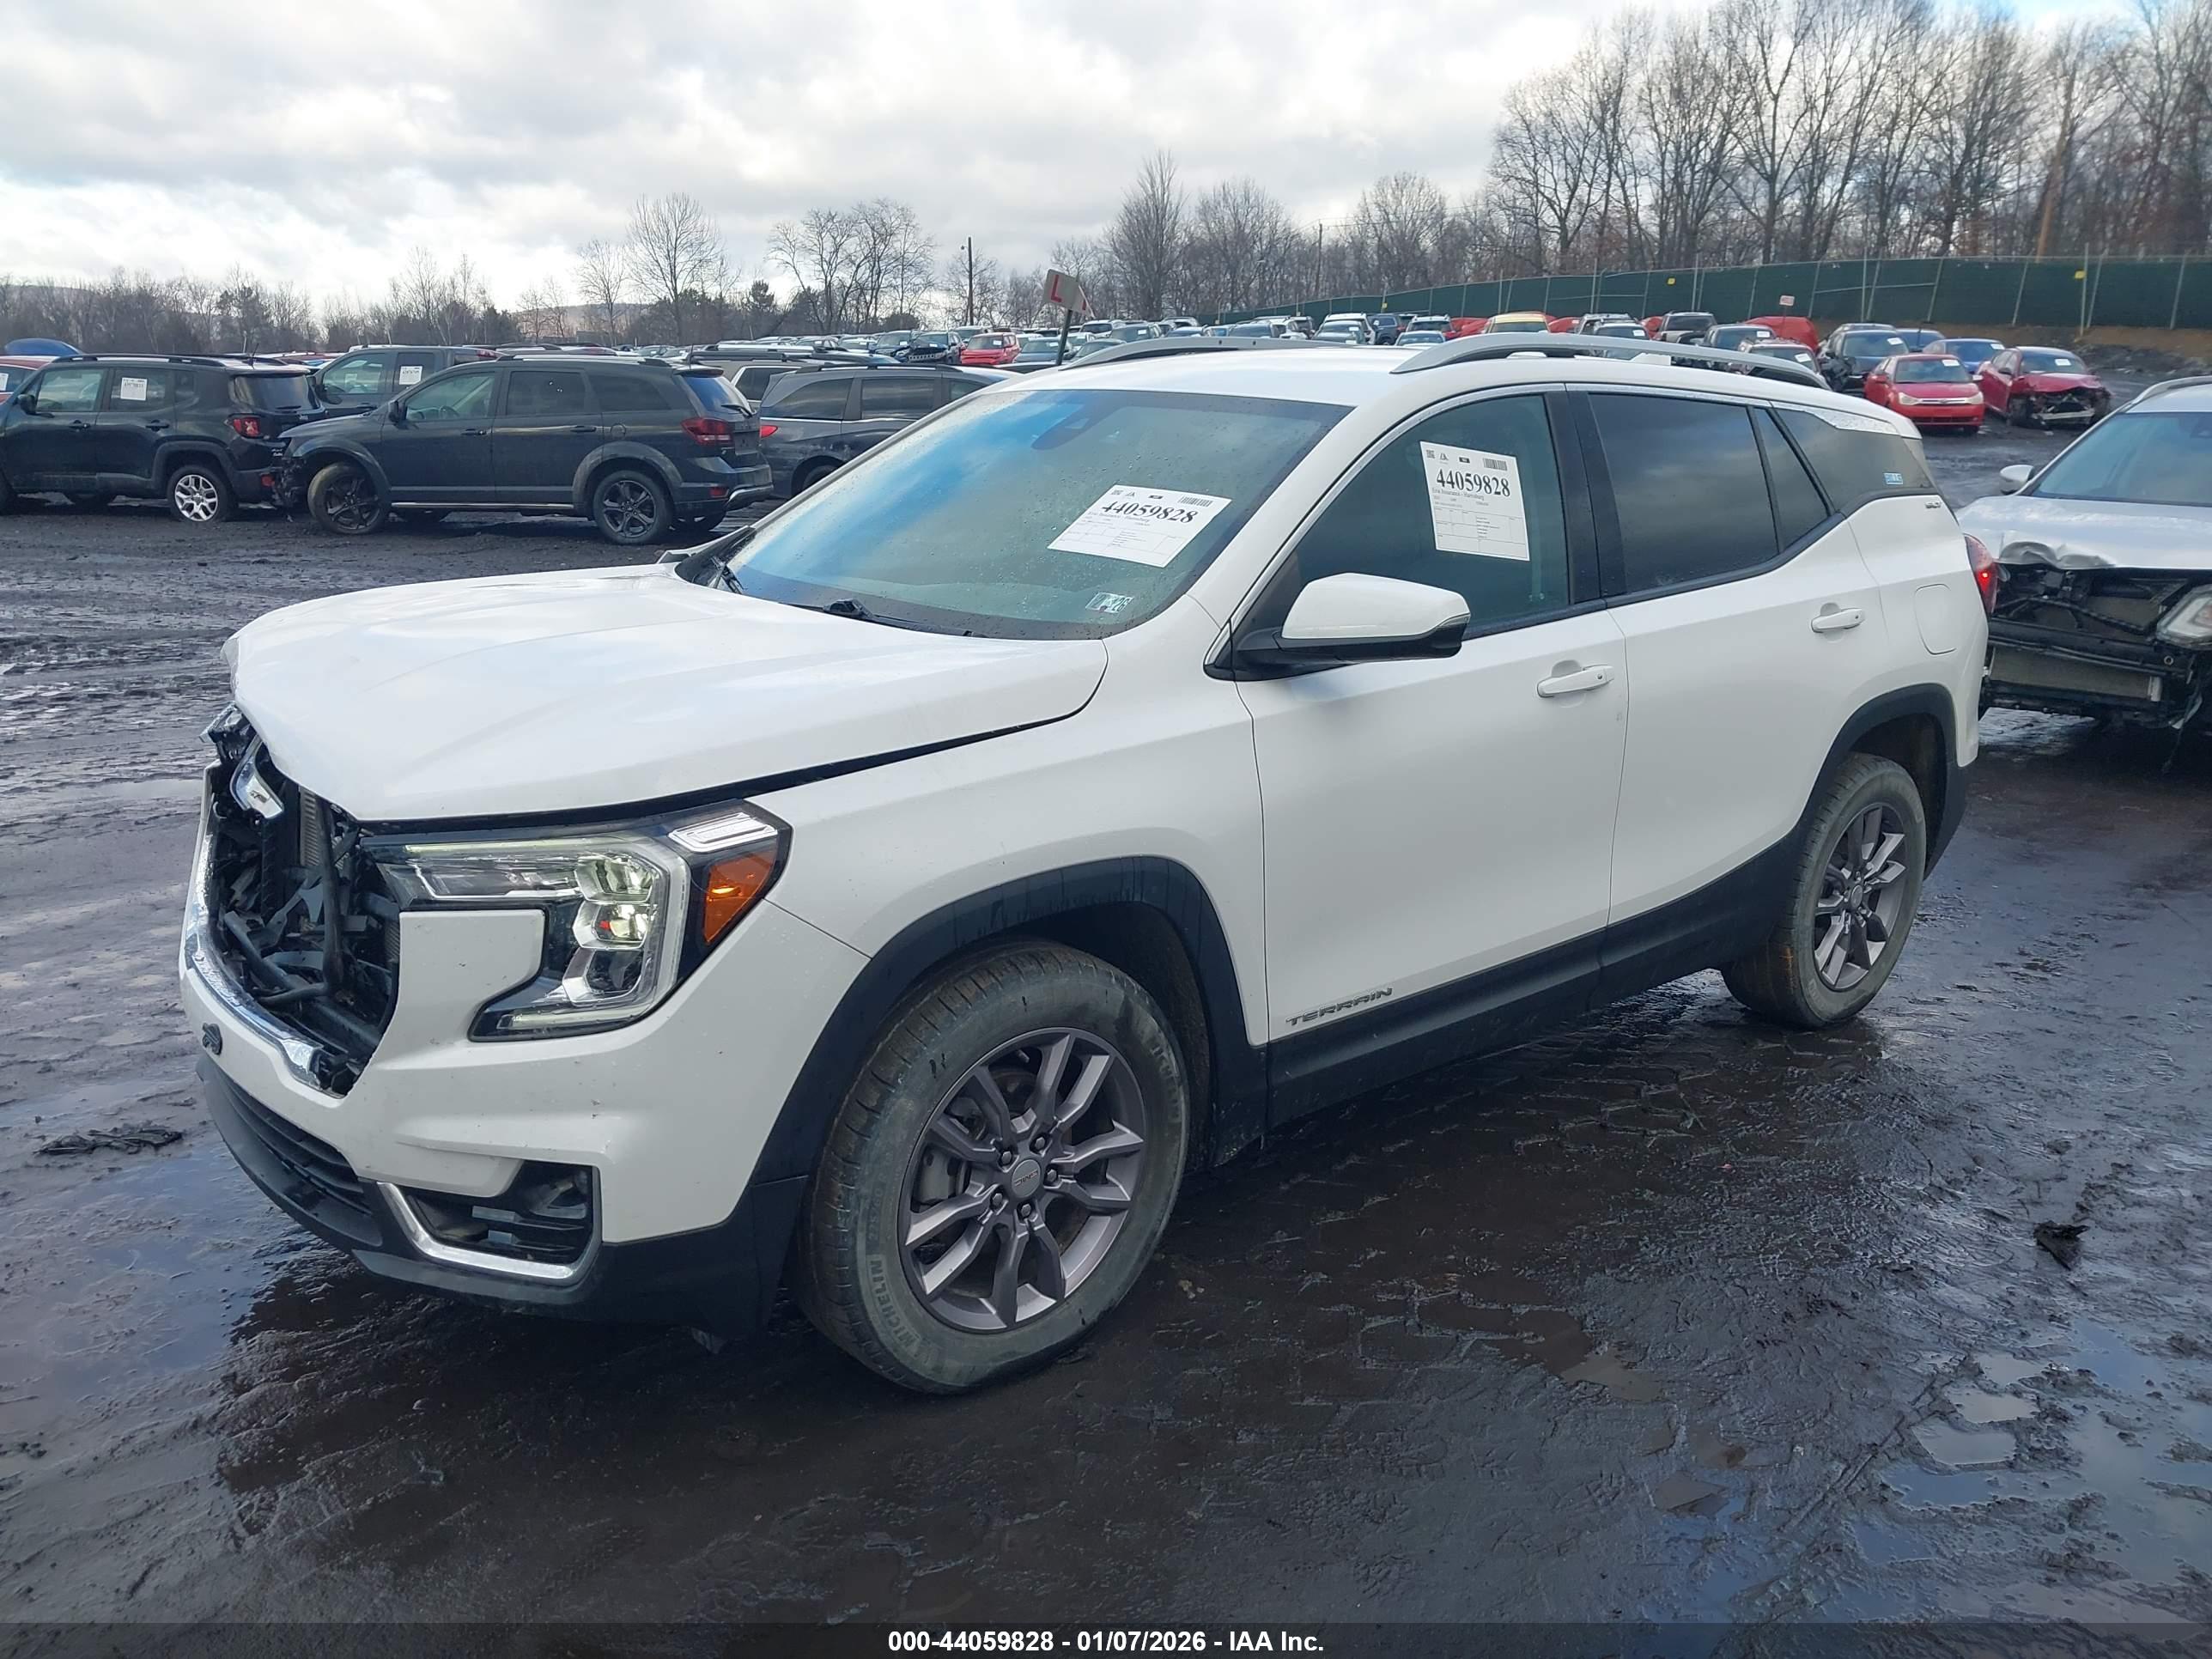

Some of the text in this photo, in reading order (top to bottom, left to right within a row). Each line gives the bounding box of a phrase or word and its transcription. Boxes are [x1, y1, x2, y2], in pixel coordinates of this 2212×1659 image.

[1436, 468, 1511, 497] 44059828
[1101, 501, 1200, 524] 44059828
[1285, 987, 1394, 1027] TERRAIN
[870, 1259, 916, 1348] MICHELIN
